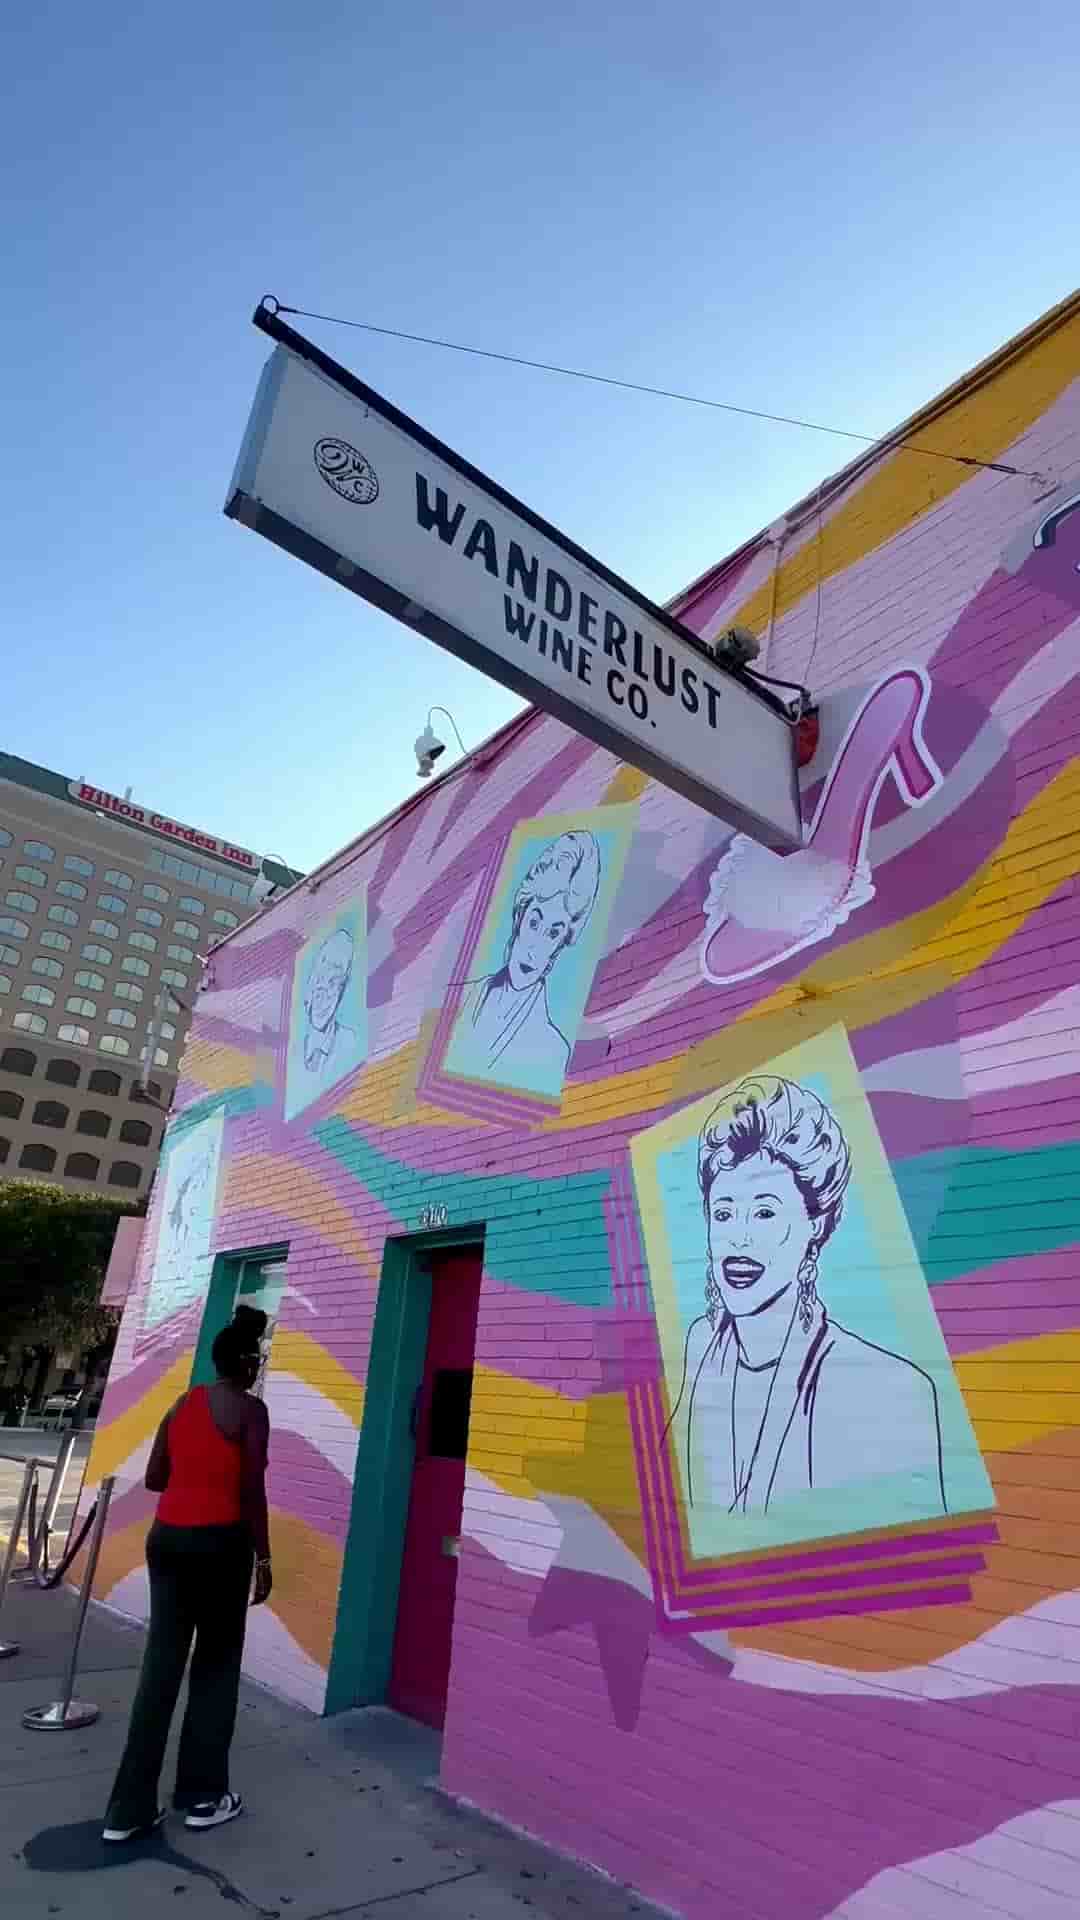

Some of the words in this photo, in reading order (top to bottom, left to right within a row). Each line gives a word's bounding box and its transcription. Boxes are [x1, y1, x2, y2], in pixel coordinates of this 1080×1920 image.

[415, 472, 721, 729] WANDERLUST
[503, 592, 592, 685] WINE
[606, 669, 656, 728] CO.
[79, 784, 144, 822] Hilton
[149, 813, 217, 851] Garden
